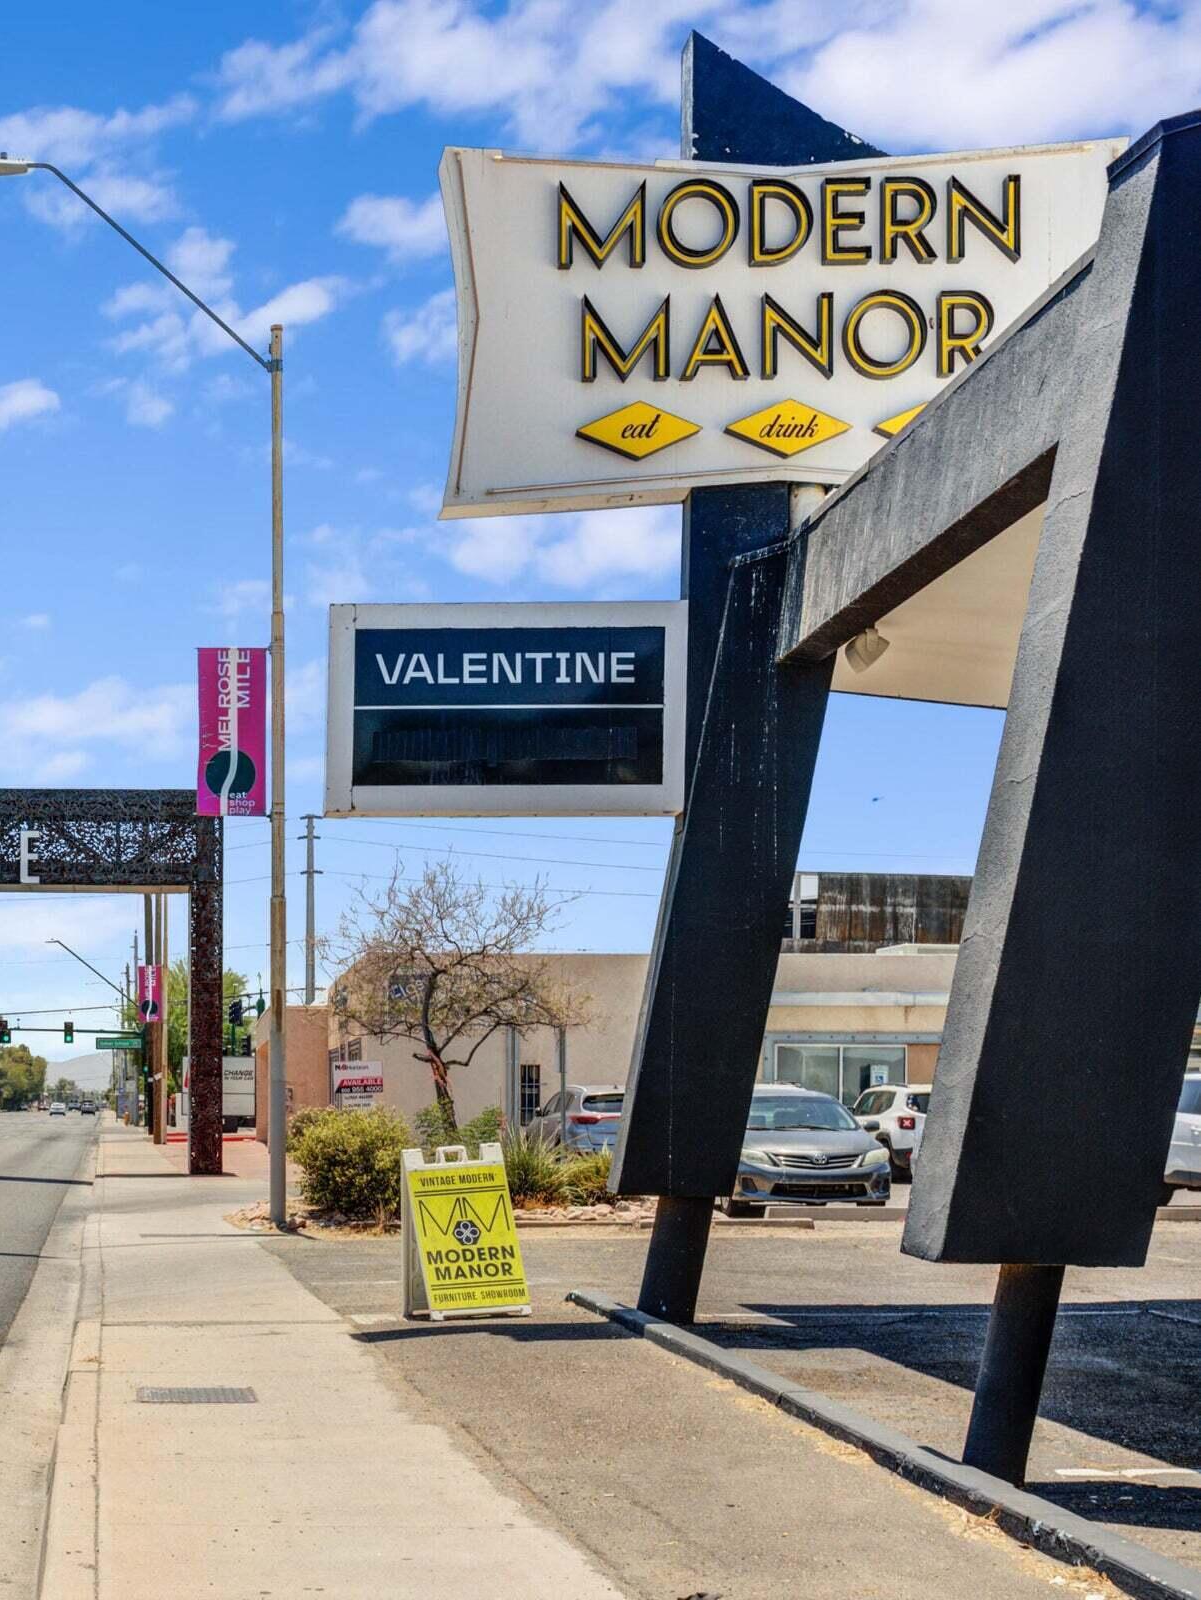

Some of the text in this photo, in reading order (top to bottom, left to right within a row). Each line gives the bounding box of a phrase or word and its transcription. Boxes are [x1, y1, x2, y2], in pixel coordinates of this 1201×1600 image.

[557, 174, 1021, 270] MODERN
[581, 289, 994, 383] MANOR
[621, 413, 820, 440] eat drink
[237, 650, 251, 708] MILE
[375, 652, 636, 685] VALENTINE
[217, 650, 232, 751] MELROSE
[229, 806, 252, 816] play
[342, 1079, 382, 1087] AVAILABLE
[426, 1245, 515, 1265] MODERN
[434, 1262, 514, 1281] MANOR
[433, 1288, 526, 1303] FURNITURE SHOWROOM
